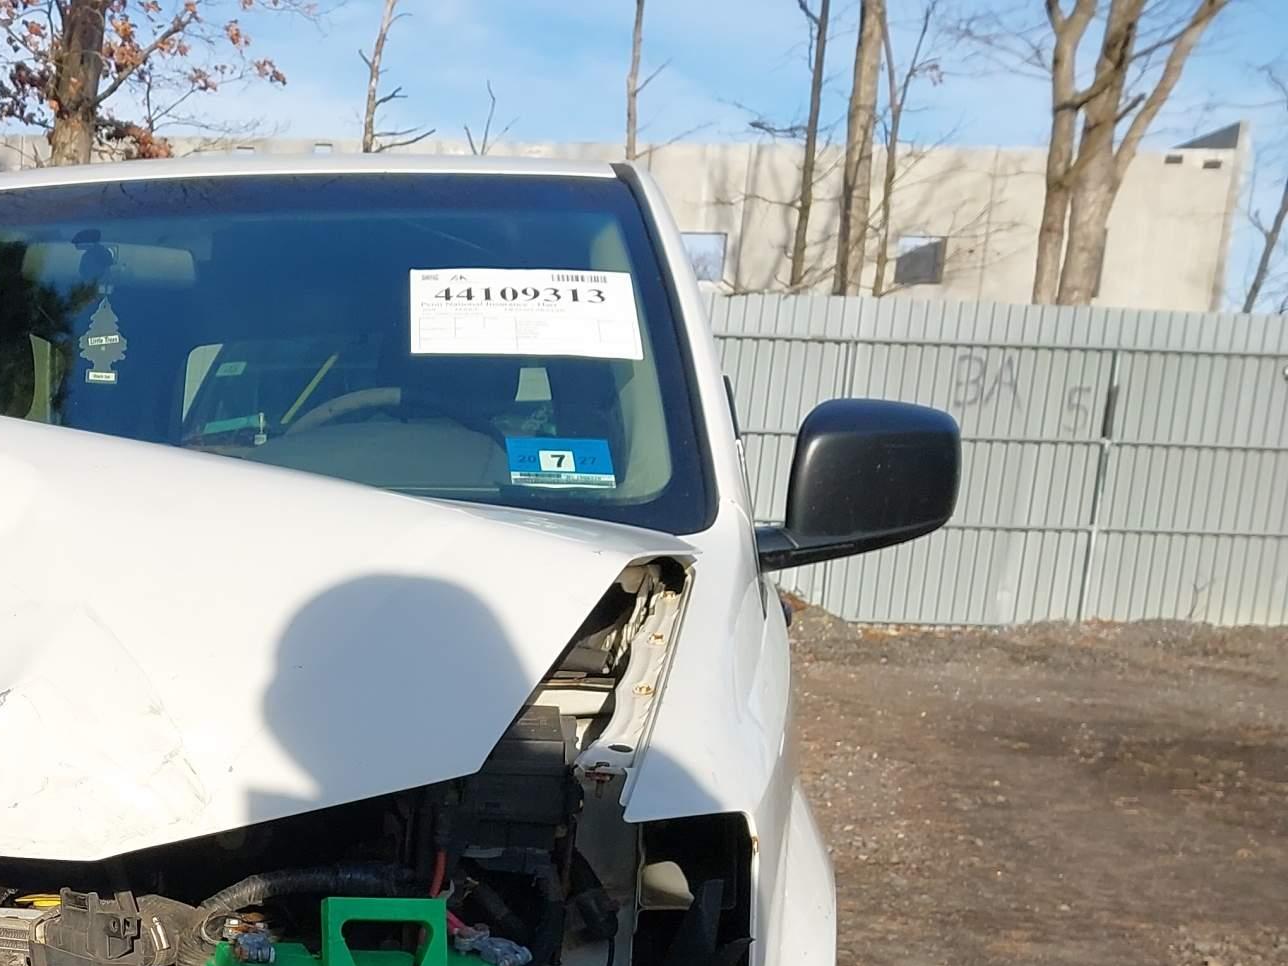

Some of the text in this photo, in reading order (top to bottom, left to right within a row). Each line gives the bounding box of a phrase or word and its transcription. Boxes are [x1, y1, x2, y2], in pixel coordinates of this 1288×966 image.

[434, 286, 606, 304] 44109313
[519, 455, 536, 463] 20
[550, 454, 565, 468] 7
